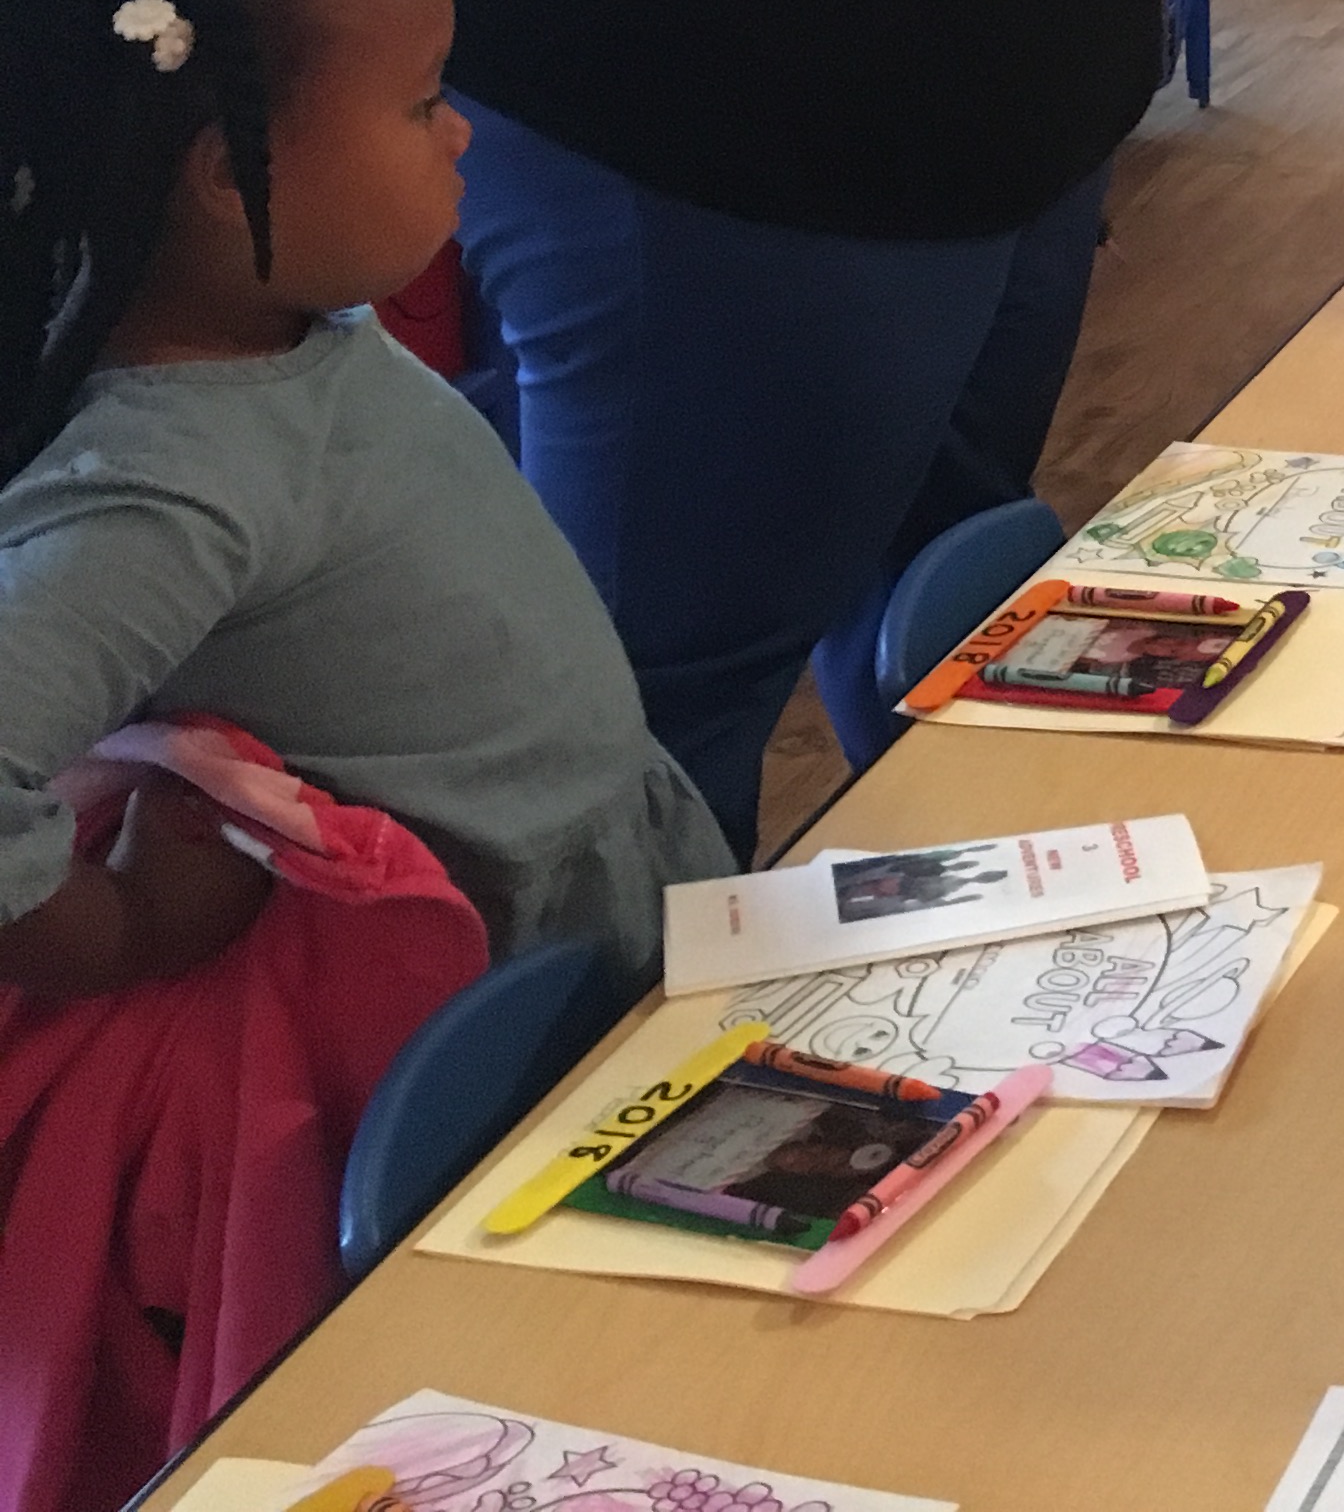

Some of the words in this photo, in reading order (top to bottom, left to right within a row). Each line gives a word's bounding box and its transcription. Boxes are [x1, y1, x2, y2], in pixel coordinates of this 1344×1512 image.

[953, 609, 1037, 667] 2018
[1081, 842, 1097, 854] 3
[1010, 930, 1115, 1034] ABOUT
[1083, 955, 1157, 1008] ALL
[567, 1079, 696, 1165] 2018
